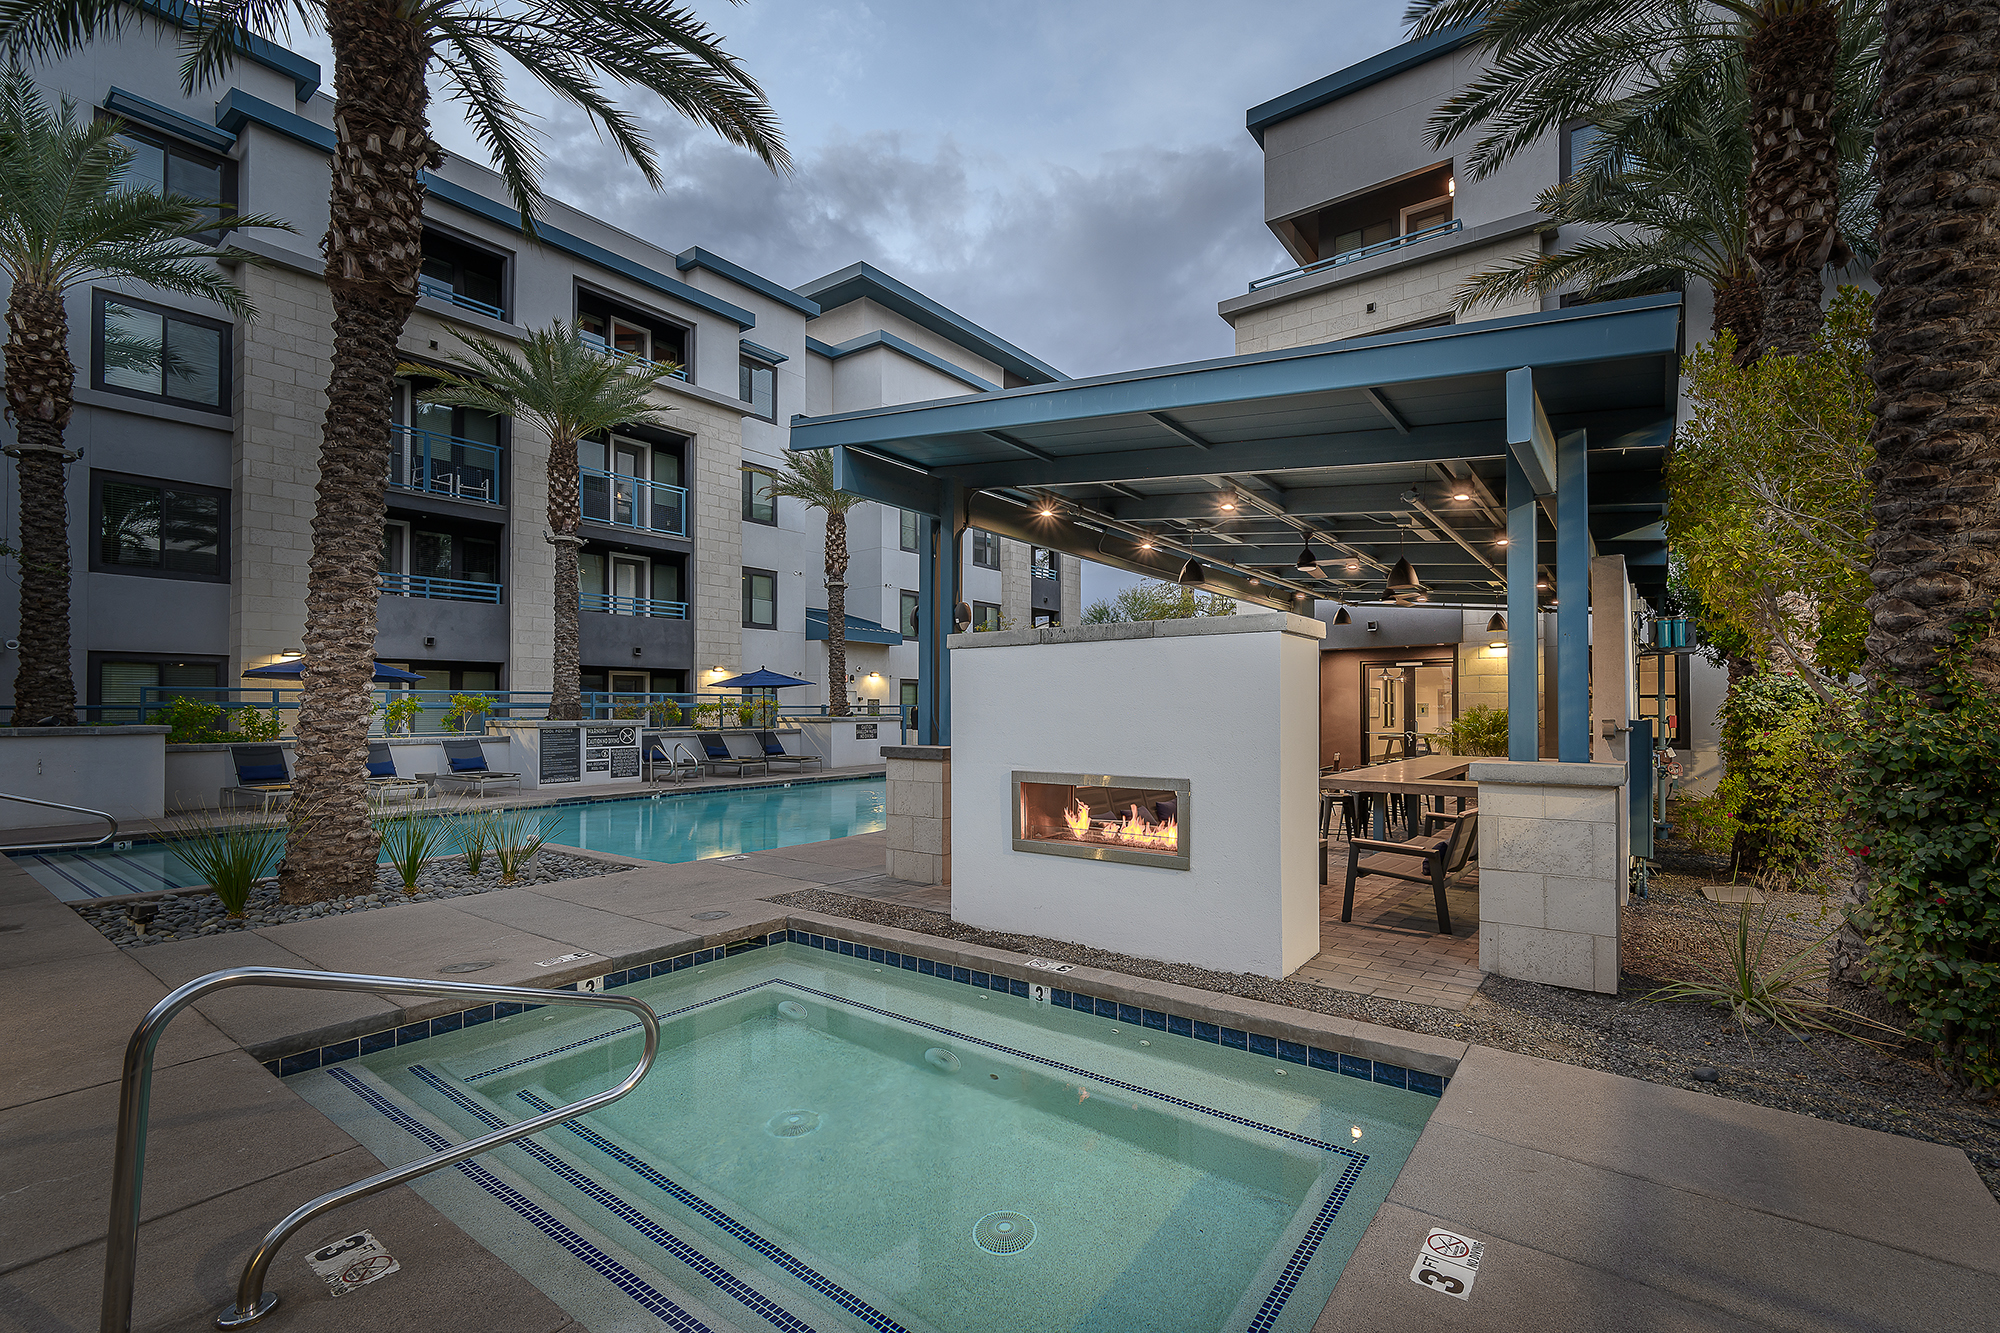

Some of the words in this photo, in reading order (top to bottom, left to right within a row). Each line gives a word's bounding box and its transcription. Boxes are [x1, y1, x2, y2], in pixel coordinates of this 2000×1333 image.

[1036, 986, 1044, 1001] 3
[314, 1235, 367, 1262] 3
[1422, 1256, 1439, 1269] FT
[1466, 1258, 1479, 1270] NO
[1418, 1268, 1465, 1295] 3
